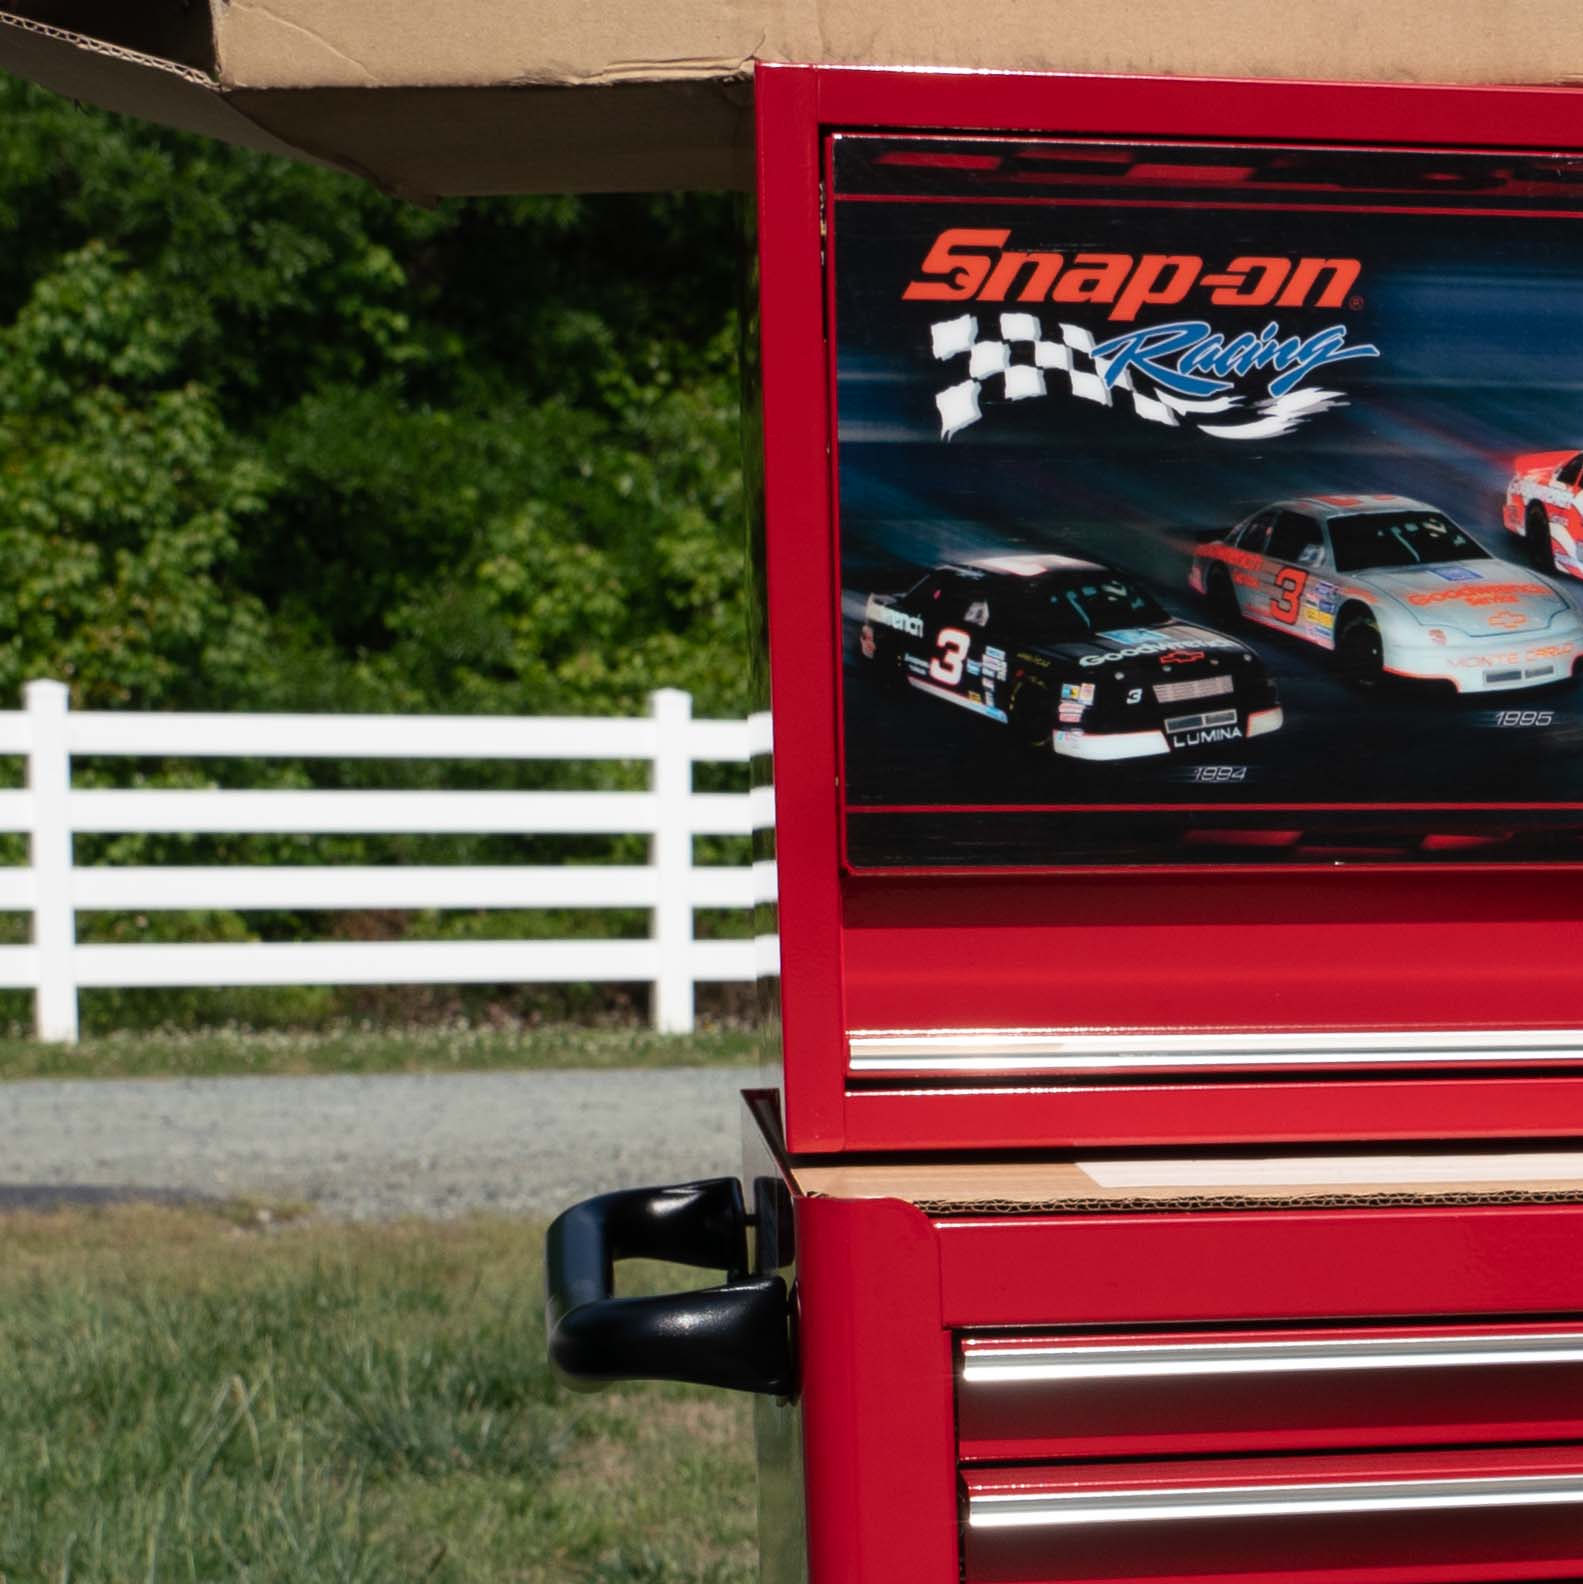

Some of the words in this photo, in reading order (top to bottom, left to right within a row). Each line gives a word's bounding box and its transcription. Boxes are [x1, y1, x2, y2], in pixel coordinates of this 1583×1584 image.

[1091, 321, 1381, 398] Racing
[1269, 566, 1310, 625] 3
[928, 627, 971, 687] 3
[1126, 687, 1144, 705] 3
[1495, 710, 1555, 727] 1995
[1173, 727, 1243, 748] LUMINA
[1192, 766, 1248, 782] 1994
